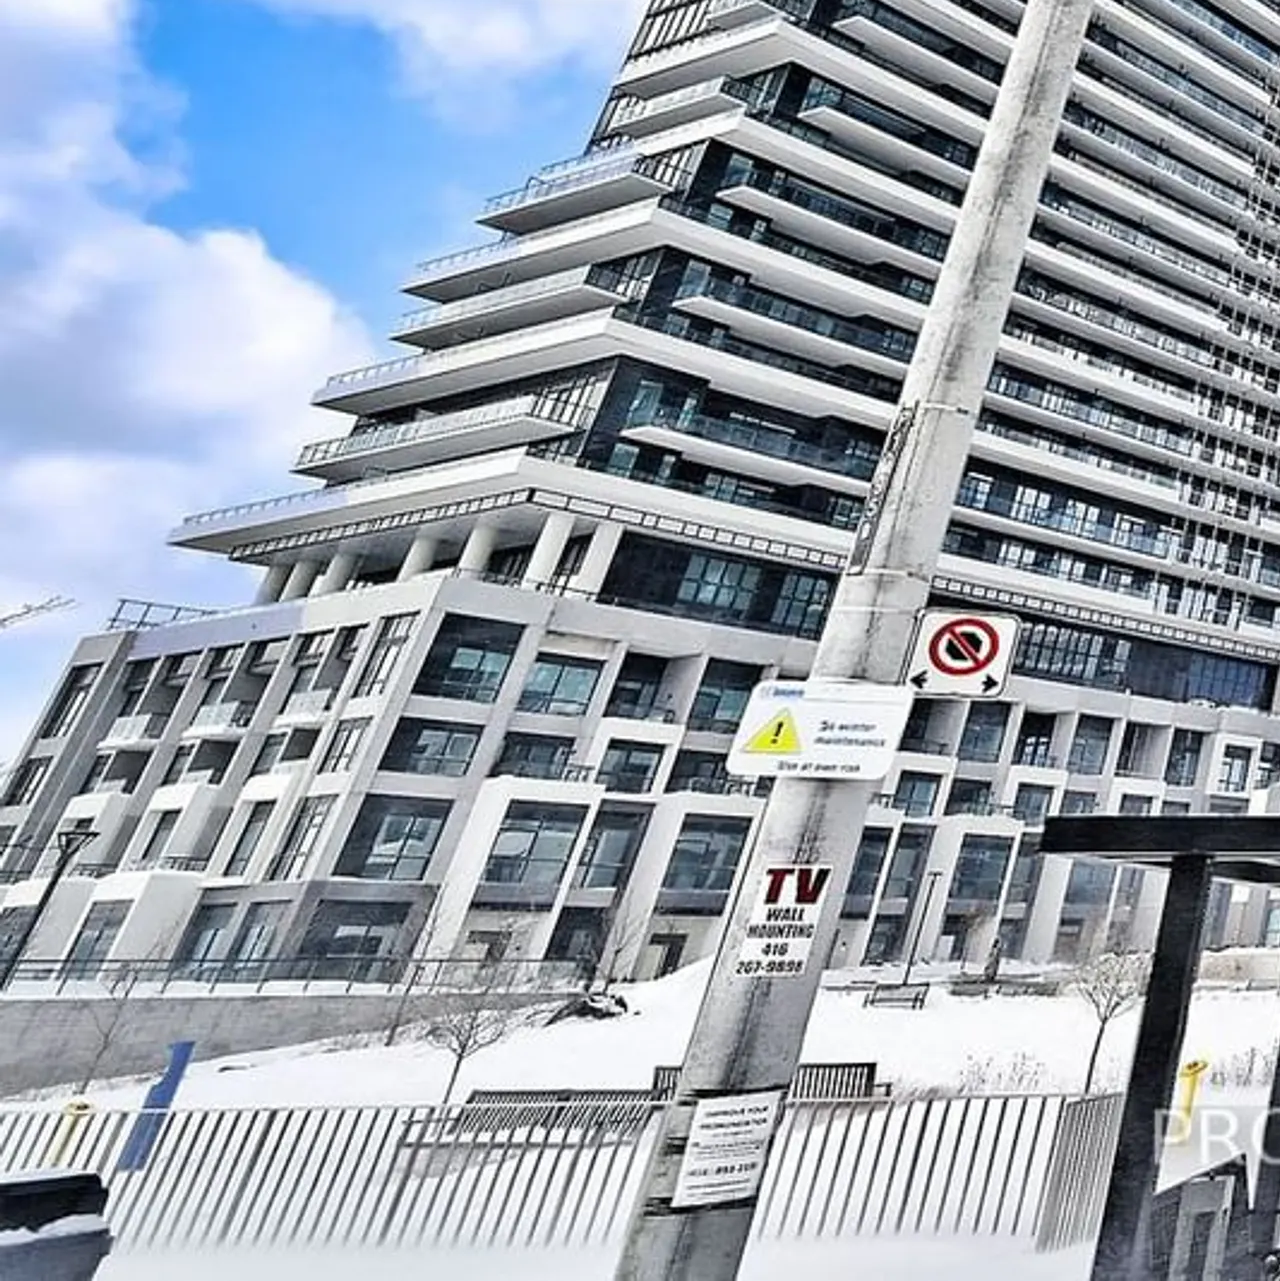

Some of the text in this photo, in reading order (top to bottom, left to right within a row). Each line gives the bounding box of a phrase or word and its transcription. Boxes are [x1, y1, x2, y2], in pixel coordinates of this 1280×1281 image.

[763, 868, 832, 905] TV
[766, 907, 805, 921] WALL
[747, 923, 815, 939] MOUNTING
[761, 942, 790, 956] 416
